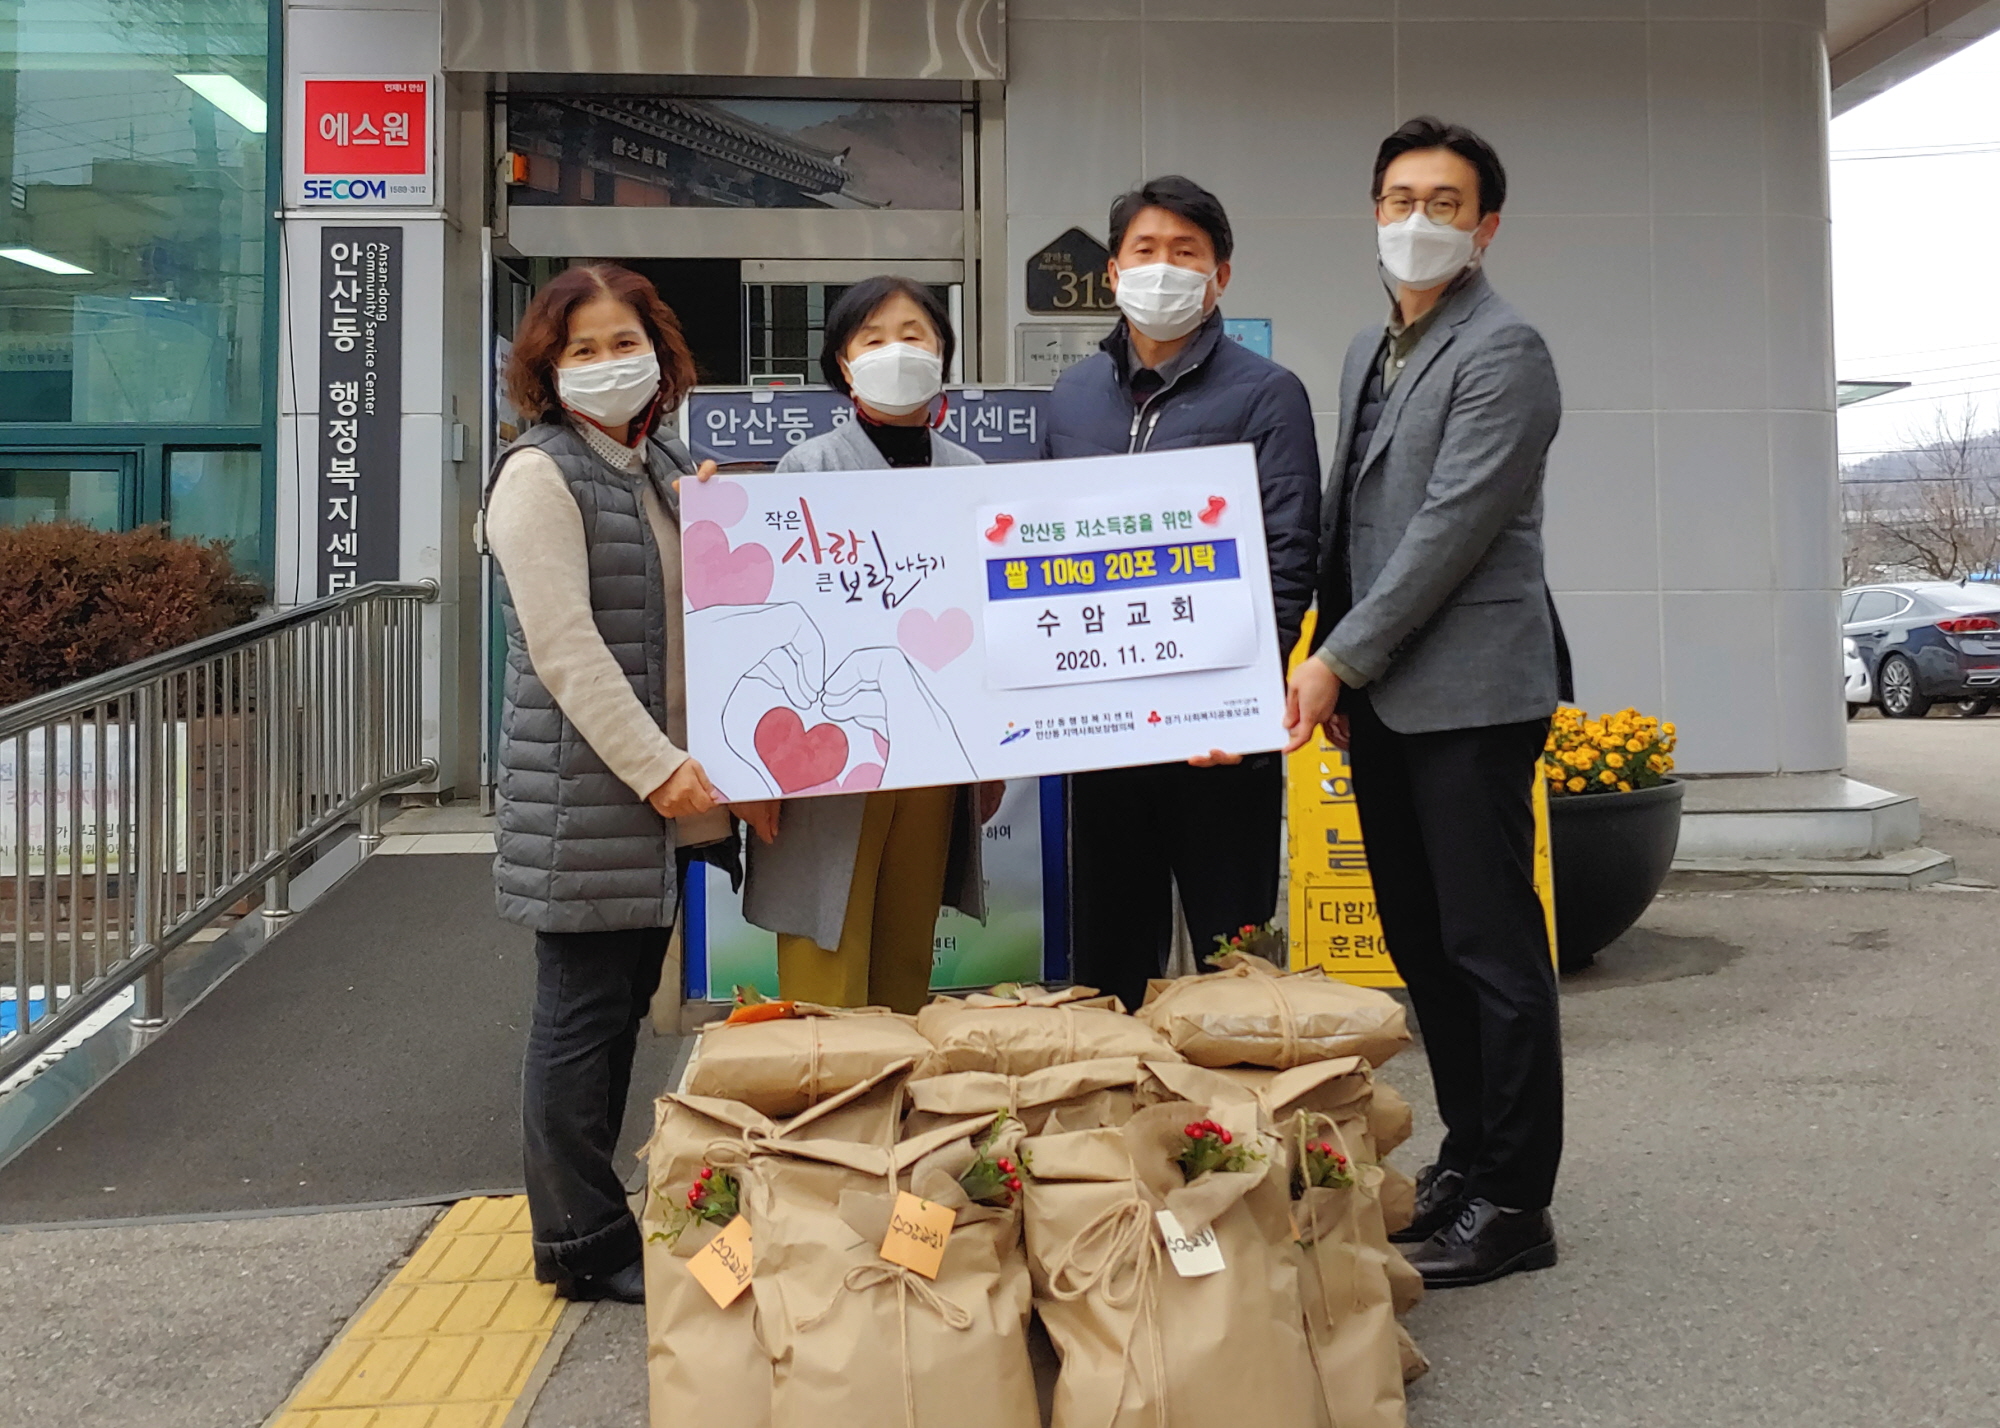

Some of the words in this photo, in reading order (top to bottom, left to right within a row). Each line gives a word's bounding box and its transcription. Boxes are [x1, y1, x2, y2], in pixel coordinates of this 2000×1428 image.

[408, 83, 424, 92] 안심
[319, 112, 409, 146] 에스원
[304, 179, 386, 199] SECOM
[389, 185, 427, 194] 1588-3112
[328, 242, 363, 353] 안산동
[363, 242, 378, 318] Community
[378, 242, 391, 322] Ansan-dong
[1053, 271, 1116, 309] 315
[364, 322, 378, 368] Service
[364, 371, 378, 417] Center
[706, 406, 813, 447] 안산동
[326, 381, 361, 596] 행정복지센터
[765, 510, 801, 530] 작은
[781, 496, 865, 565] 사랑
[1020, 522, 1066, 543] 안산동
[1161, 510, 1193, 531] 위한
[816, 572, 834, 592] 큰
[839, 530, 922, 610] 보람
[895, 553, 946, 579] 나누기
[1004, 560, 1029, 590] 쌀
[1040, 557, 1095, 586] 10kg
[1105, 549, 1158, 581] 20포
[1167, 543, 1216, 575] 기탁
[1056, 650, 1107, 671] 2020.
[1117, 645, 1145, 665] 11.
[1155, 640, 1184, 660] 20.
[1036, 730, 1060, 740] 안산동
